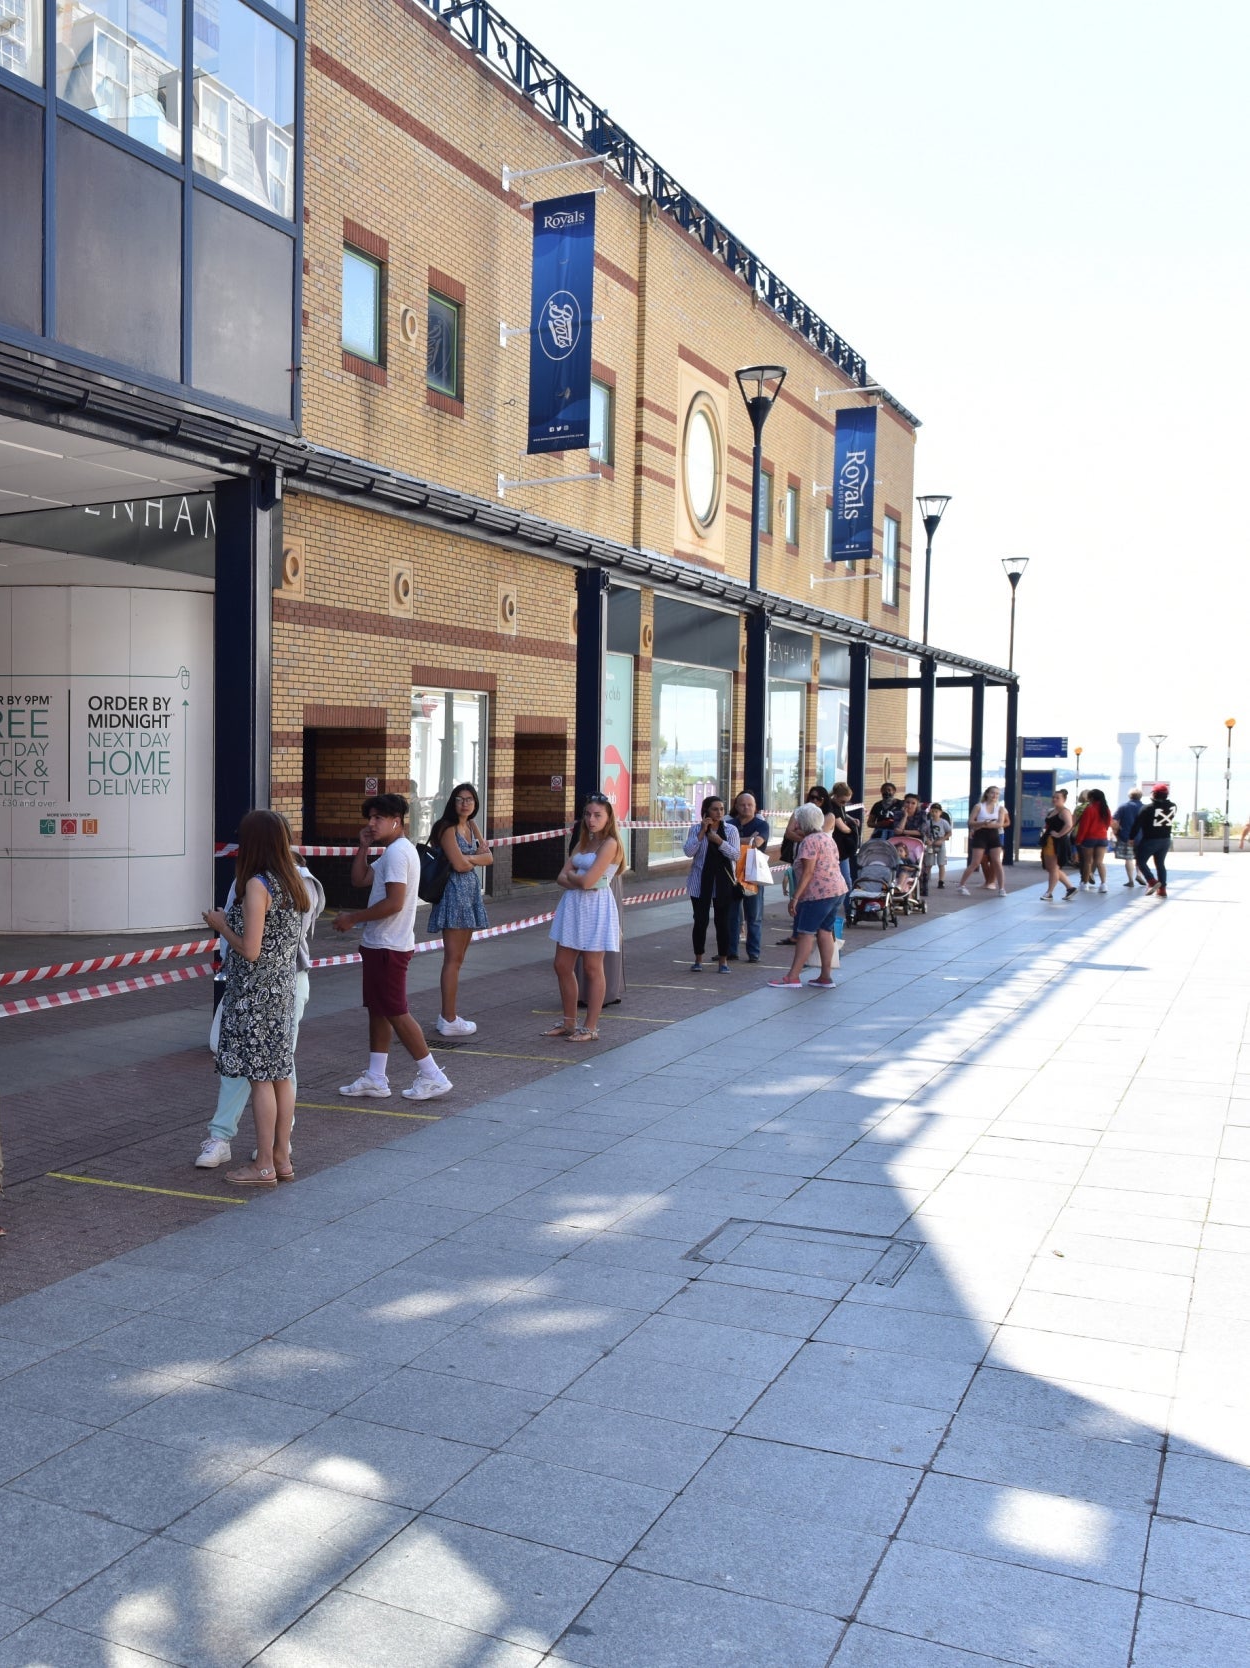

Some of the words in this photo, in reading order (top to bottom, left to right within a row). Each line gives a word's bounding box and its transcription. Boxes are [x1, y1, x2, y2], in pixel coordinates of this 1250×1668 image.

[543, 211, 585, 228] Royals
[548, 300, 573, 348] Boots
[839, 449, 869, 520] Royals
[7, 695, 22, 706] BY
[88, 695, 148, 711] ORDER
[152, 696, 171, 711] BY
[88, 732, 135, 748] NEXT
[140, 732, 171, 748] DAY
[14, 742, 49, 757] DAY
[33, 759, 49, 777] &
[88, 750, 171, 776] HOME
[88, 779, 171, 796] DELIVERY
